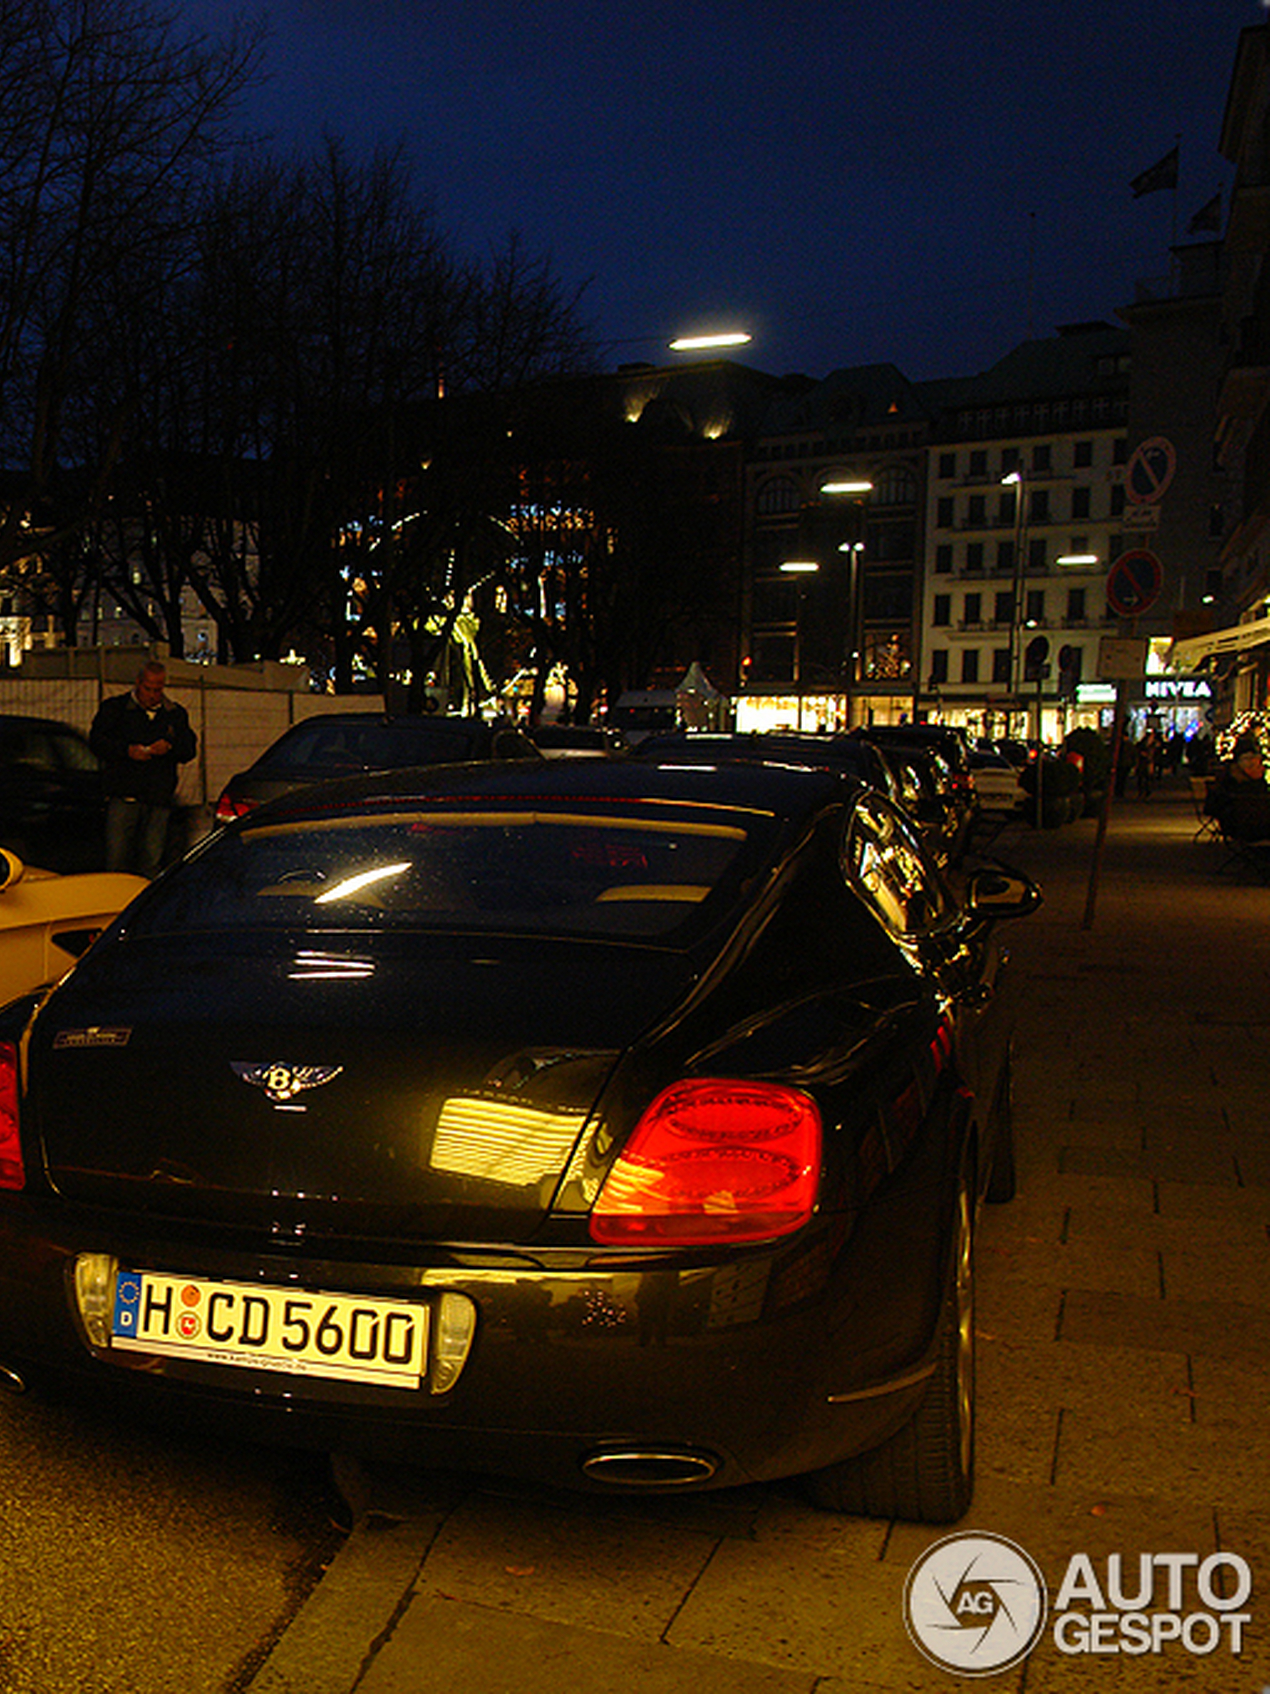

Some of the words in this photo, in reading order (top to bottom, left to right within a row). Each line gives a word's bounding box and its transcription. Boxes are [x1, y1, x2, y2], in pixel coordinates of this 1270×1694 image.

[1145, 681, 1212, 698] NIVEA
[142, 1284, 173, 1335] H
[206, 1292, 268, 1347] CD
[282, 1301, 415, 1365] 5600
